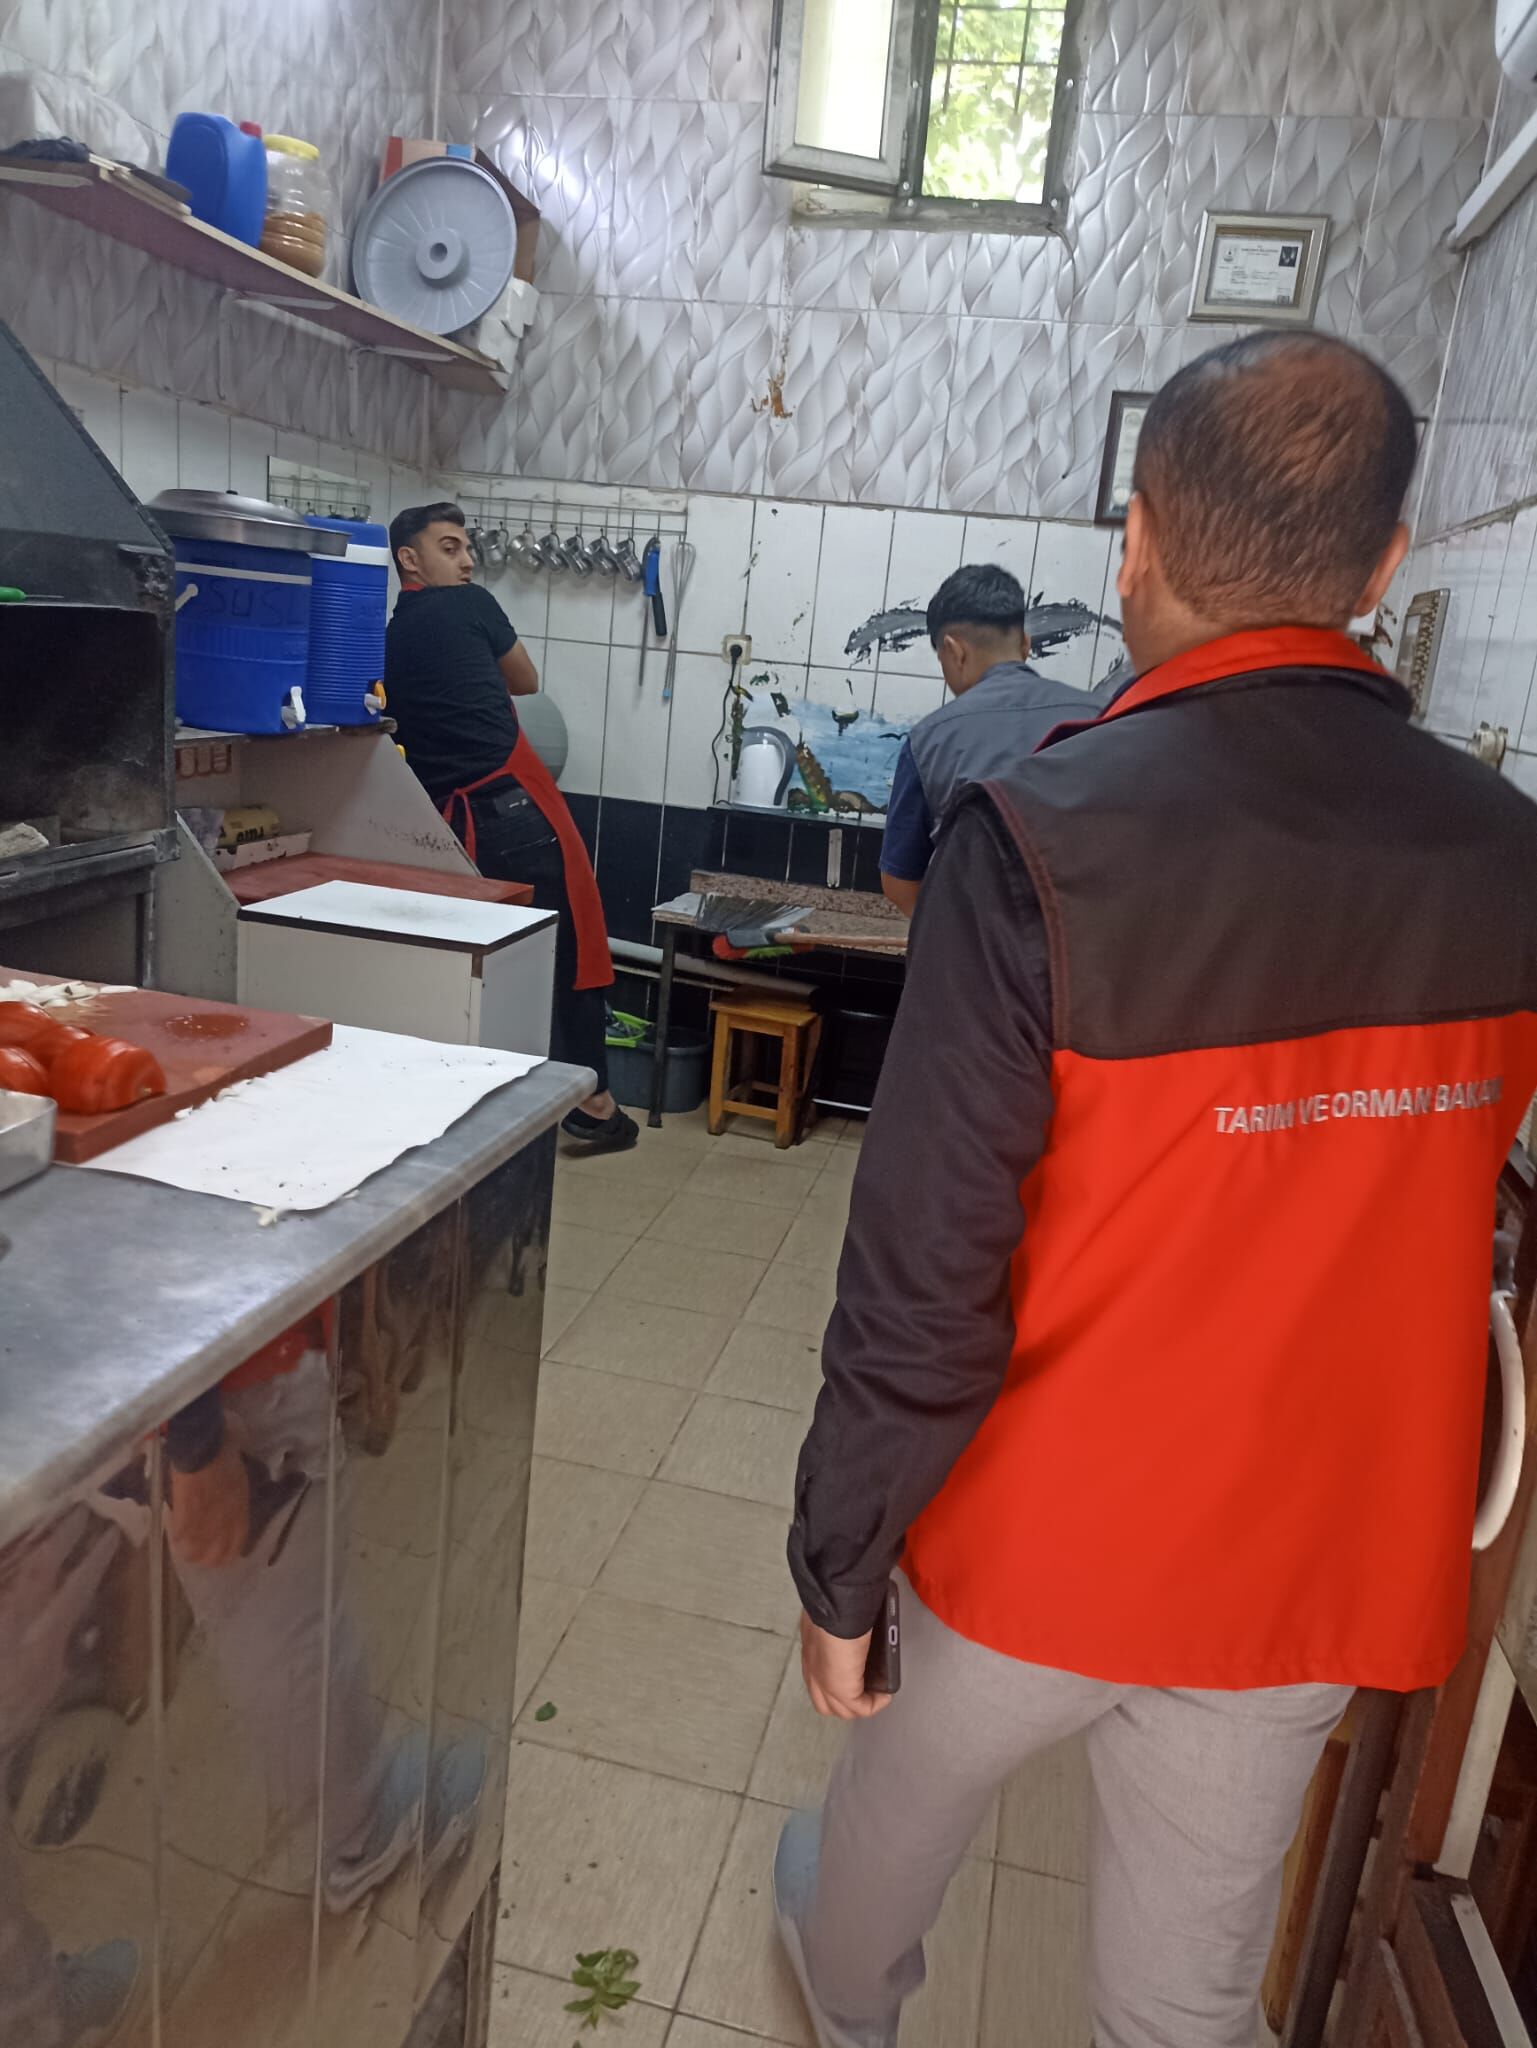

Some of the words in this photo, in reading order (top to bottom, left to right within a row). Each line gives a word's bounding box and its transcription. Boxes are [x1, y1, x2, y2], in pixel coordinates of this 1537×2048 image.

[1213, 1102, 1295, 1134] TARIM
[1300, 1094, 1330, 1125] VE
[1331, 1087, 1432, 1118] ORMAN
